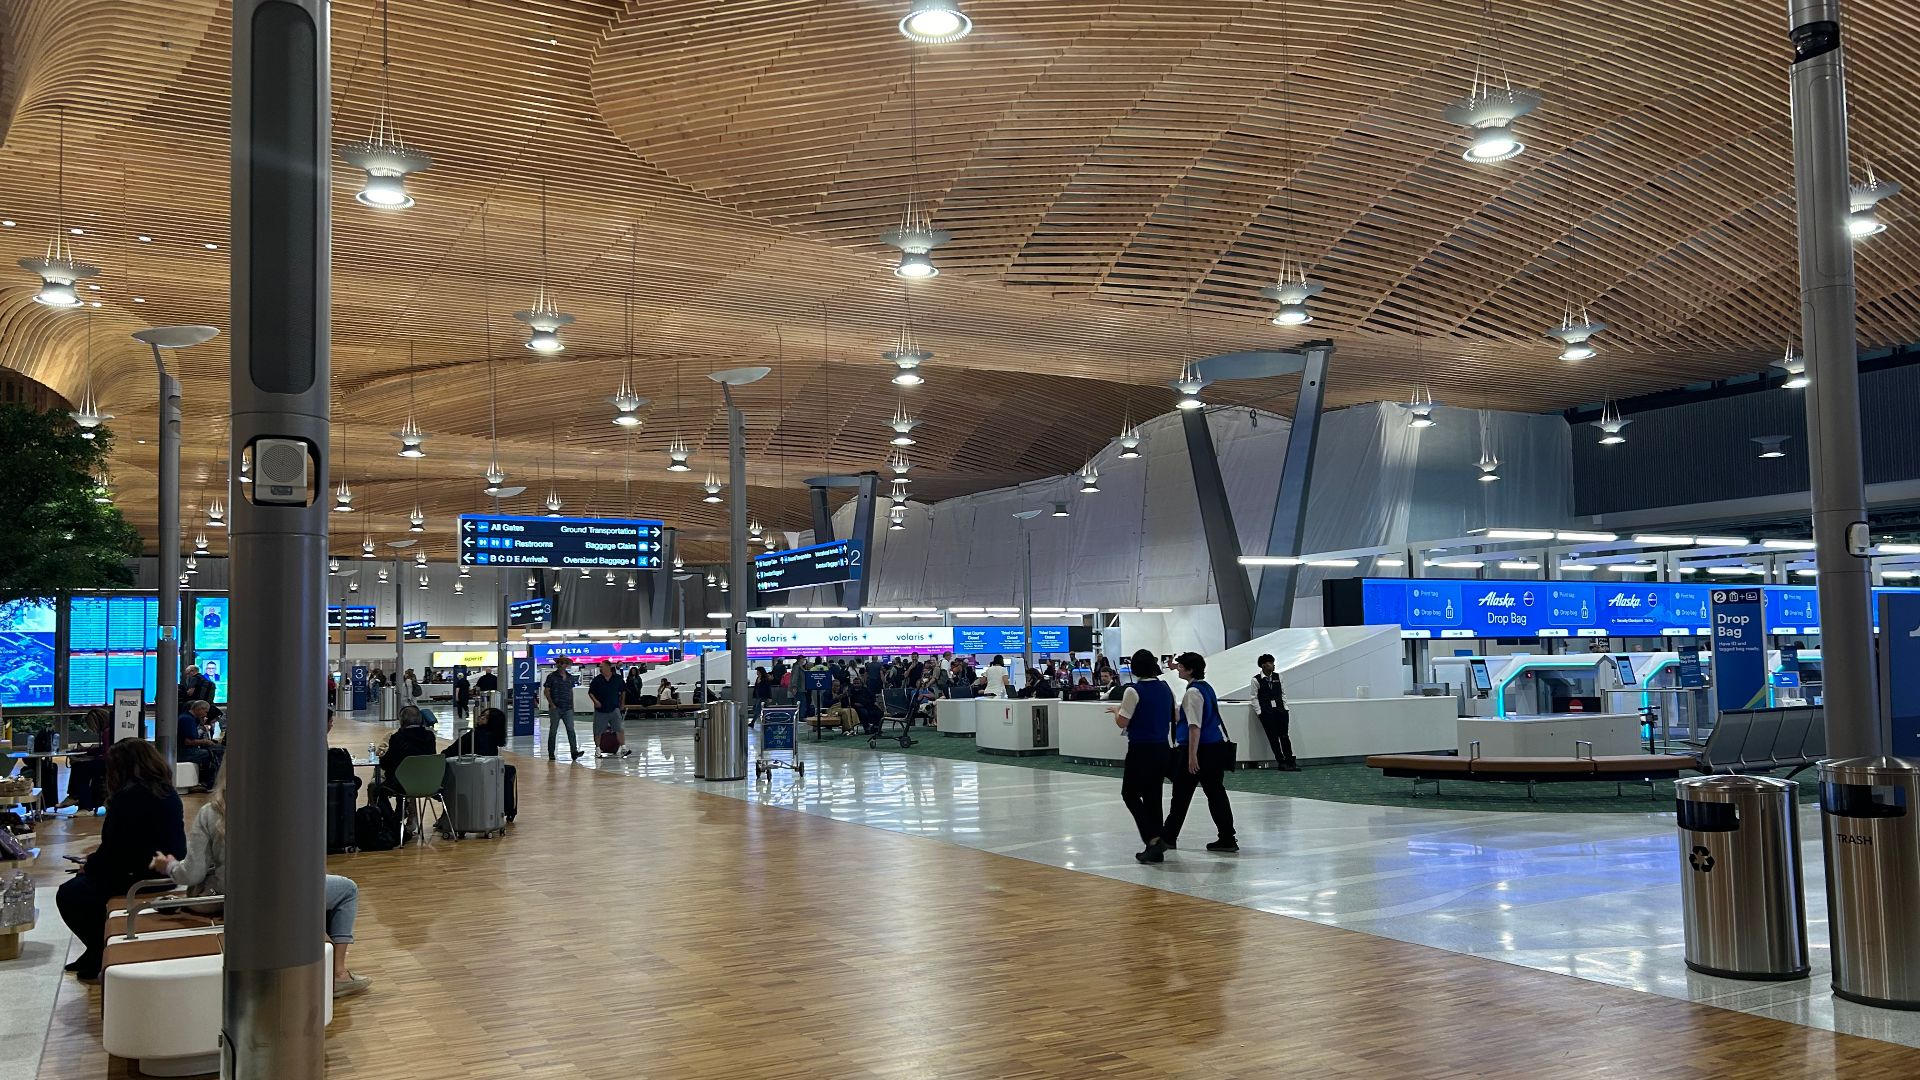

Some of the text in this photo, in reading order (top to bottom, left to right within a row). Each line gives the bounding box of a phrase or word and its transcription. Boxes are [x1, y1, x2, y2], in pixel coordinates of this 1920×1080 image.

[502, 524, 524, 532] Gates
[588, 527, 636, 535] Transportation
[515, 540, 553, 548] Restrooms
[585, 542, 616, 550] Baggage
[599, 557, 629, 565] Baggage
[850, 550, 860, 565] 2
[1478, 591, 1515, 608] Alaska
[1609, 592, 1641, 608] Alaska
[544, 604, 551, 614] 3
[1488, 612, 1527, 626] Drop Bag
[1717, 614, 1750, 625] Drop
[828, 633, 858, 641] volaris
[1718, 627, 1742, 638] Bag
[756, 634, 787, 642] volaris
[356, 669, 363, 679] 3
[519, 662, 530, 679] 2
[127, 722, 135, 730] Day
[1837, 834, 1872, 846] TRASH
